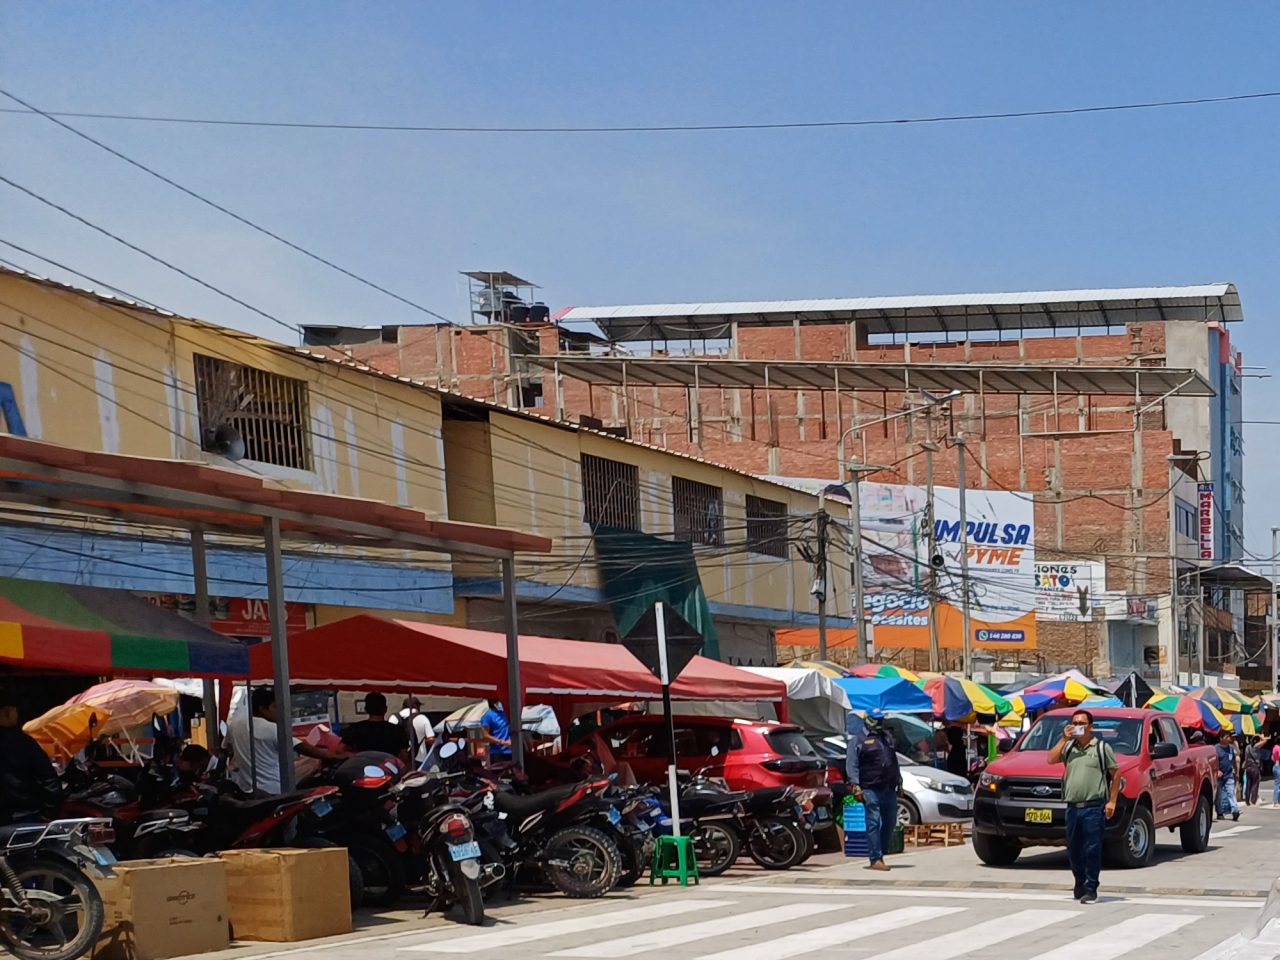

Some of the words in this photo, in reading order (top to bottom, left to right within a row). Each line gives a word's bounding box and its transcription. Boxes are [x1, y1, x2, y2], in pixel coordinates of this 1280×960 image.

[934, 519, 1031, 546] IMPULSA
[1200, 492, 1213, 559] MARBELLA
[961, 543, 1025, 566] PYME
